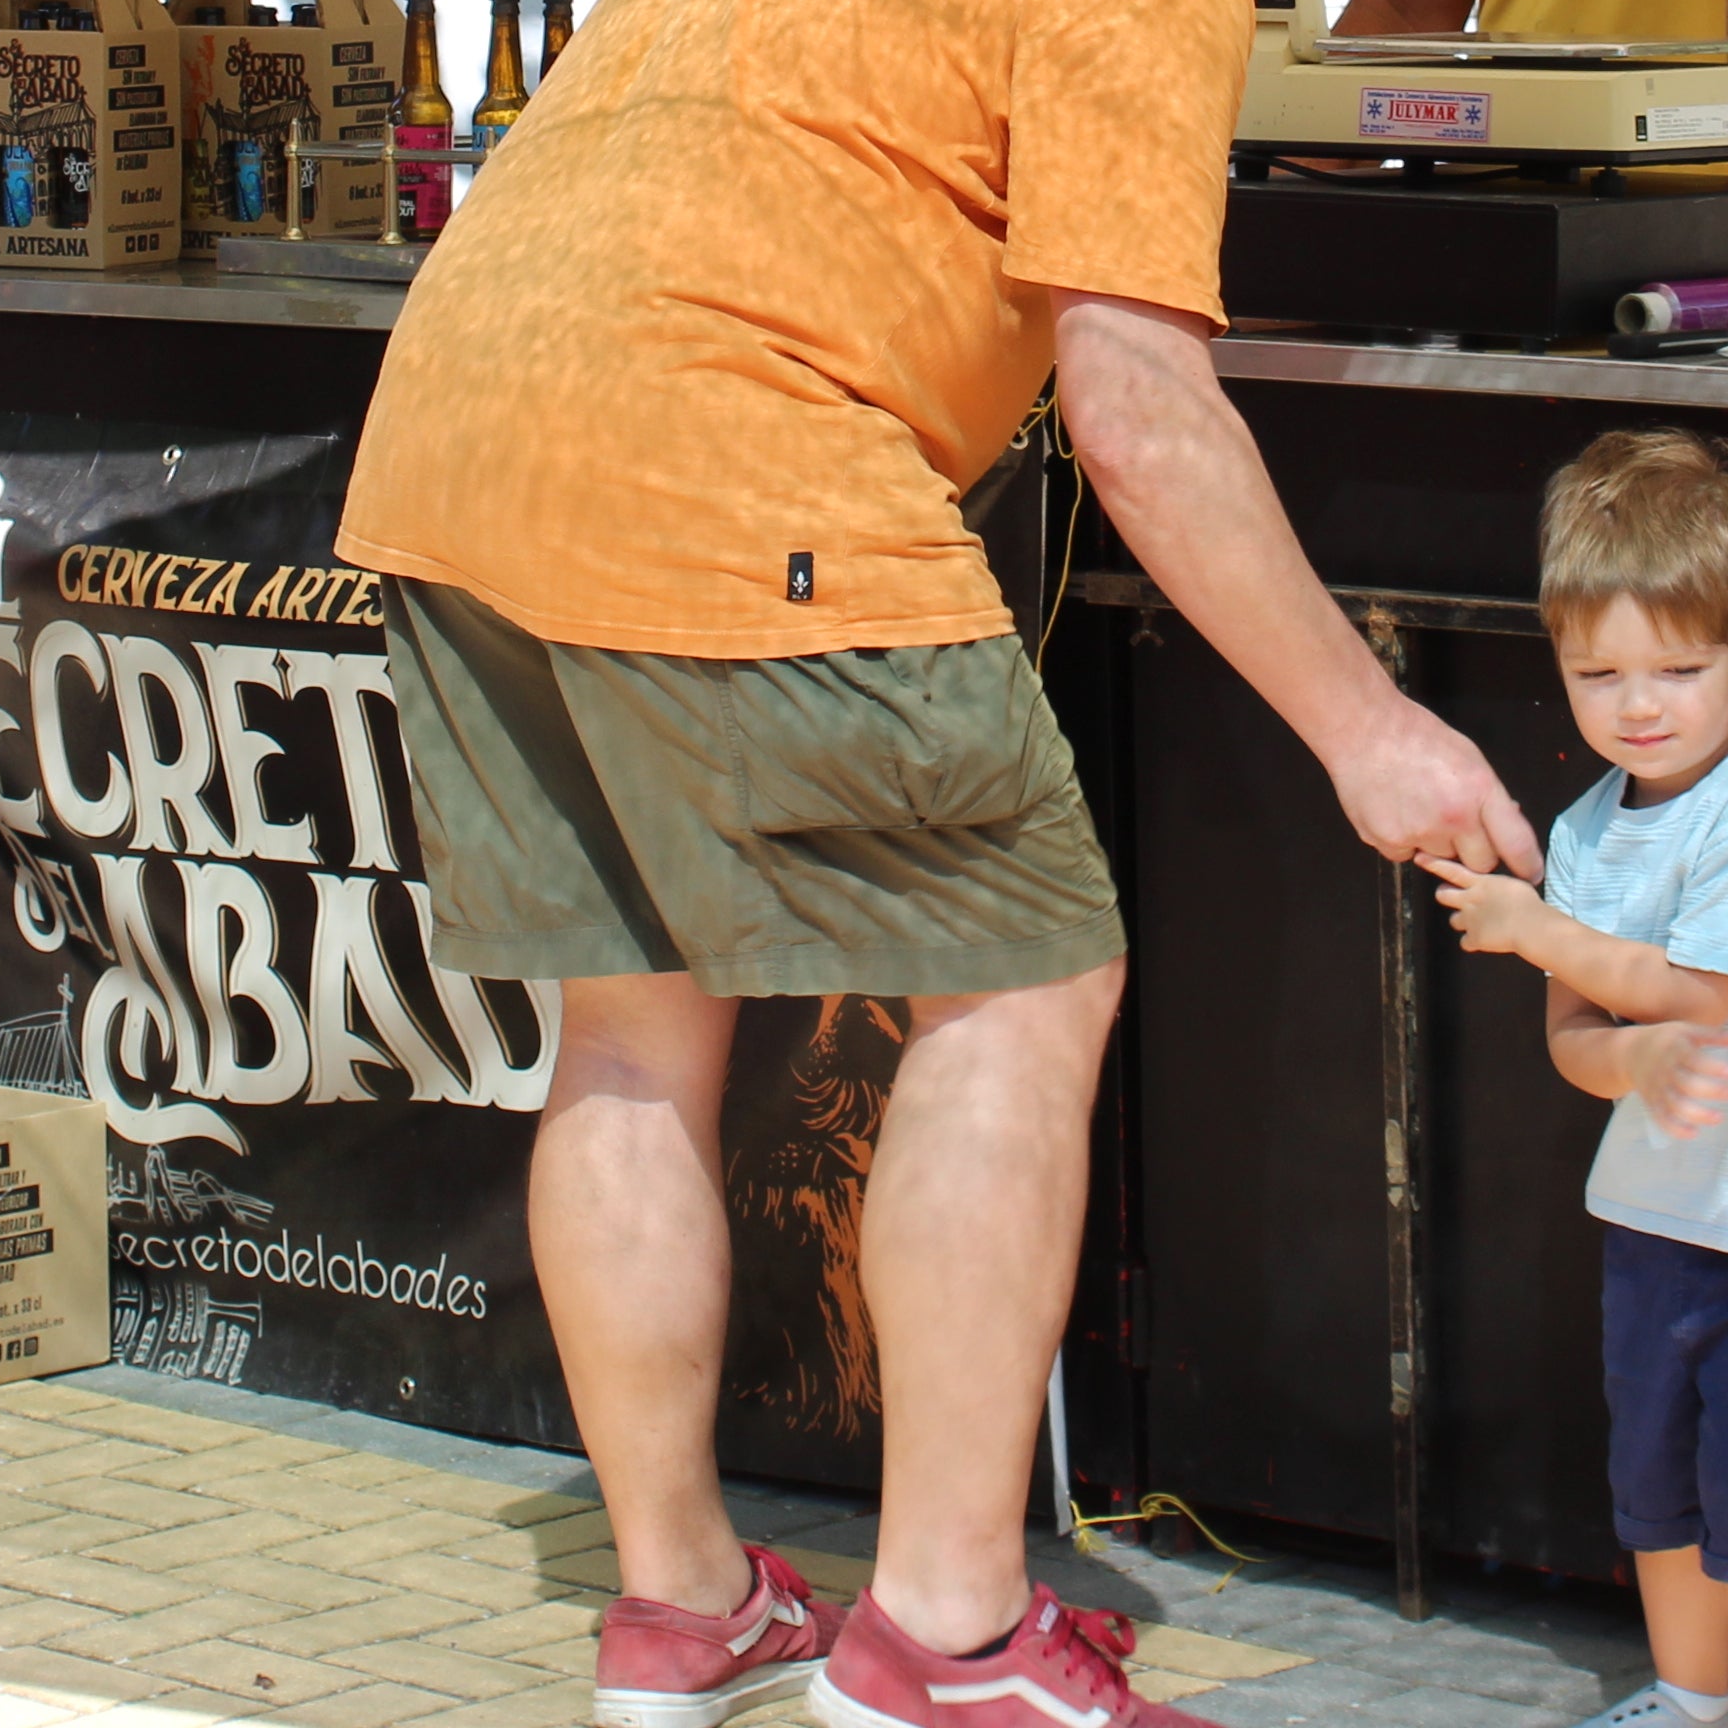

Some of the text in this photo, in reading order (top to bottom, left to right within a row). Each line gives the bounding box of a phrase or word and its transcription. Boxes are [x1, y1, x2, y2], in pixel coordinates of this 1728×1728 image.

[226, 45, 305, 77] SECRETO
[1387, 99, 1460, 125] JULYMAR
[6, 236, 89, 258] ARTESANA
[57, 543, 250, 617] CERVEZA
[81, 853, 564, 1158] ABAD
[15, 1231, 48, 1257] PRIMAS
[21, 1296, 32, 1312] 33
